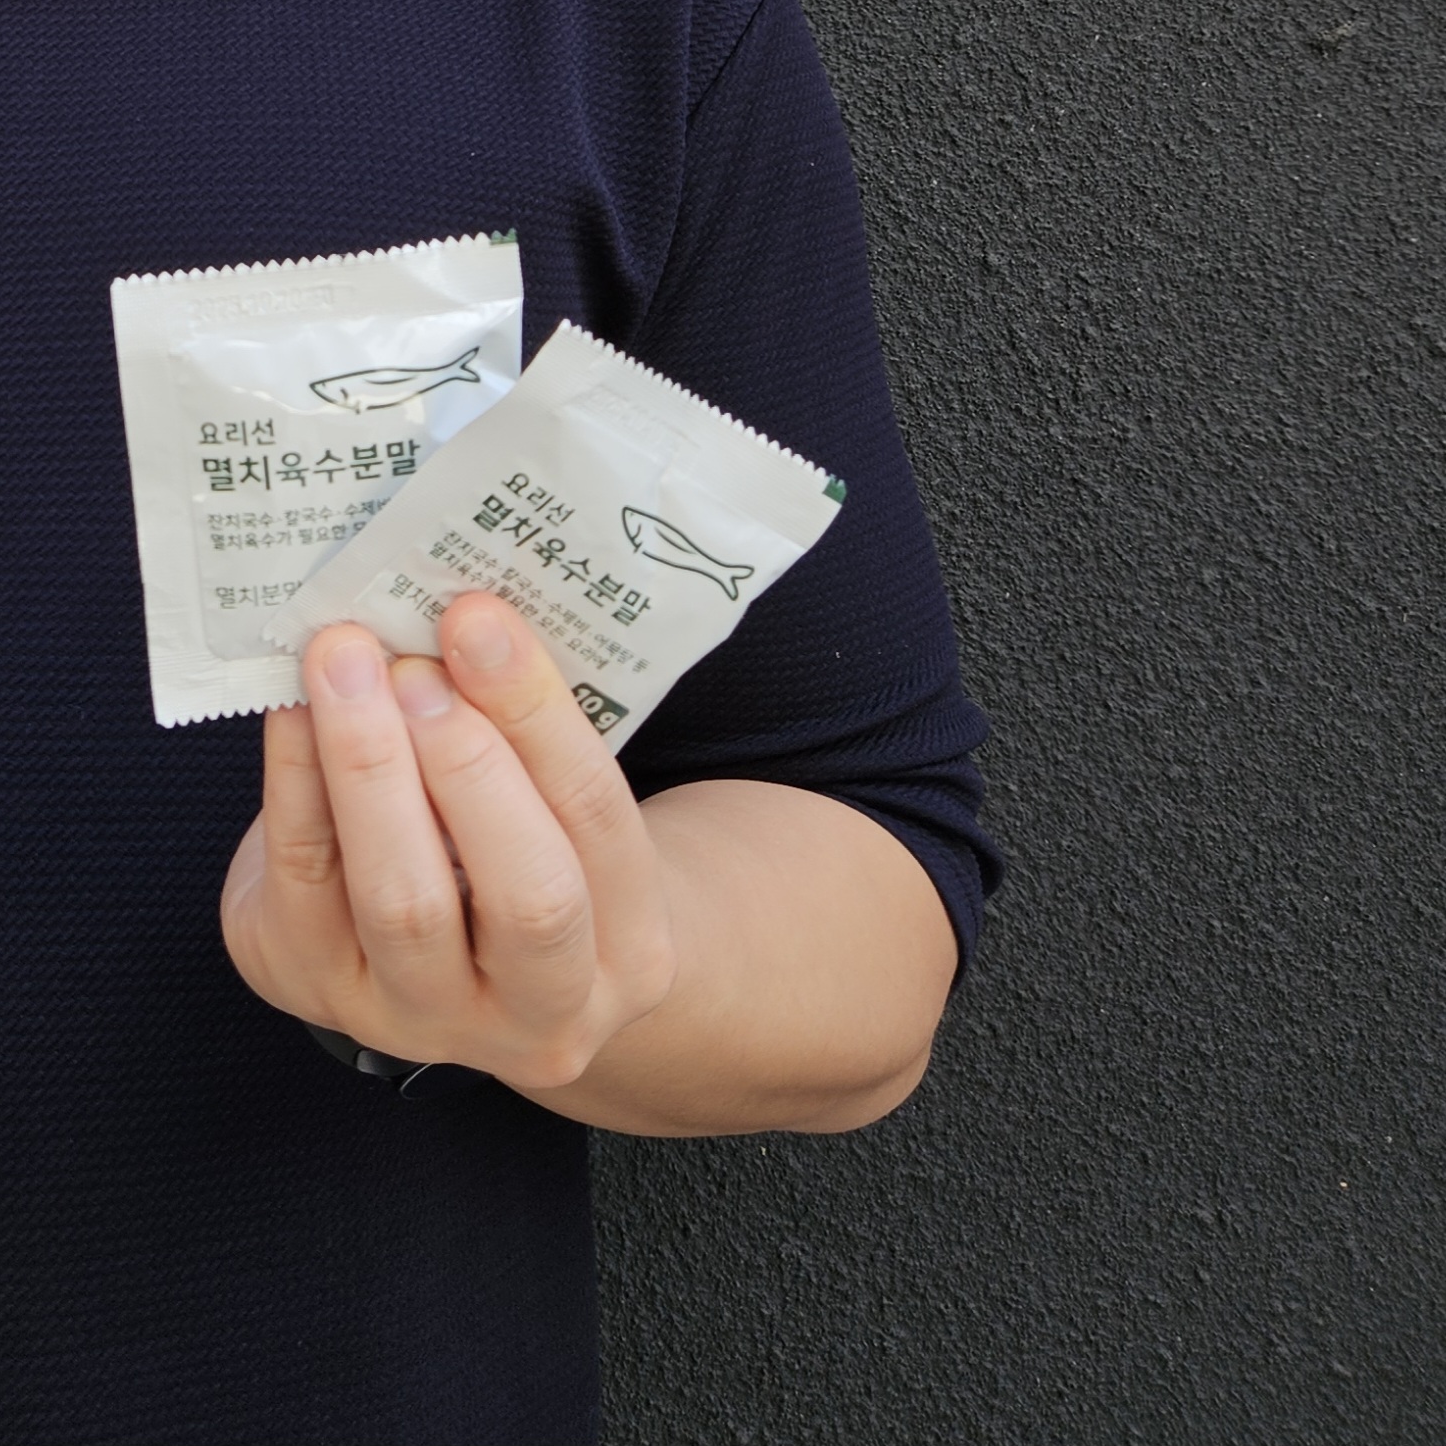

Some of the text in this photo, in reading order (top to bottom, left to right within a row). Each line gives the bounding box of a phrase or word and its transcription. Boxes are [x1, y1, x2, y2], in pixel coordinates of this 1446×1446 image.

[199, 418, 276, 446] 요리선
[202, 439, 421, 492] 멸치육수분말
[501, 472, 575, 526] 요리선
[211, 530, 292, 550] 멸치육수가
[298, 524, 346, 545] 필요한
[473, 494, 652, 627] 멸치육수분말
[429, 541, 609, 671] 멸치육수가 필요한 모든 요리에
[632, 658, 651, 674] 등
